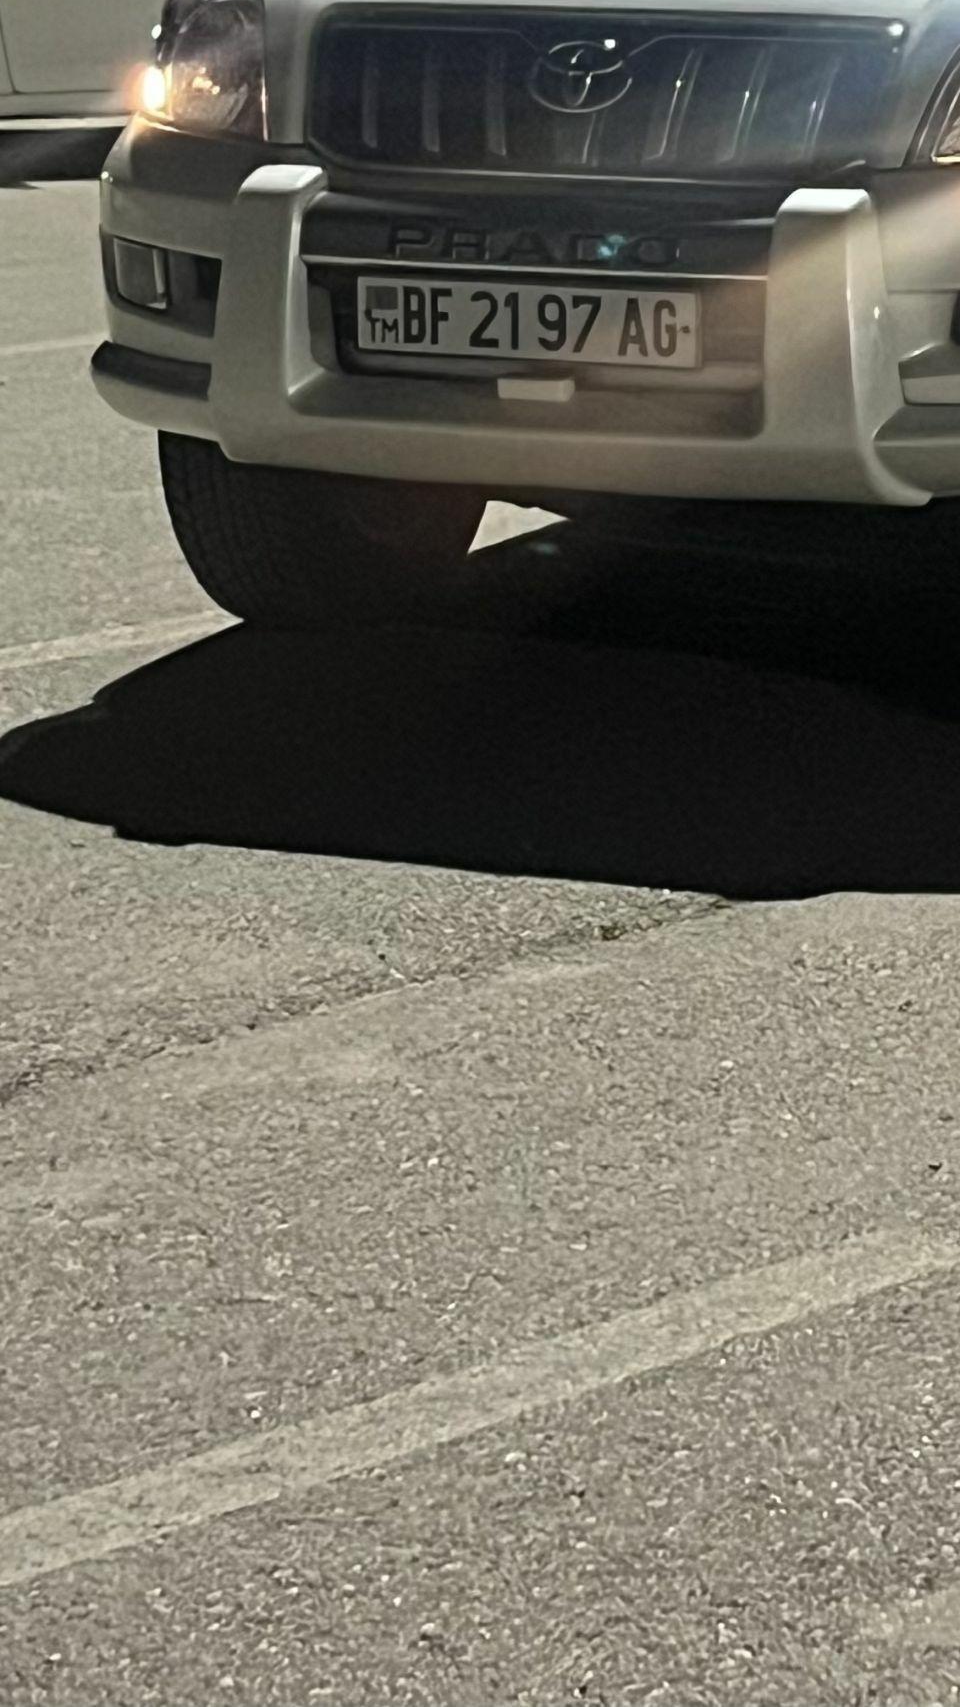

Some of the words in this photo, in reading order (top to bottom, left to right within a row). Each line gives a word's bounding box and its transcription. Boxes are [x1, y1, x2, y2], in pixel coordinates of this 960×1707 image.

[387, 222, 681, 265] PRADO
[367, 317, 399, 344] TM
[402, 285, 453, 345] BF
[617, 297, 677, 357] AG
